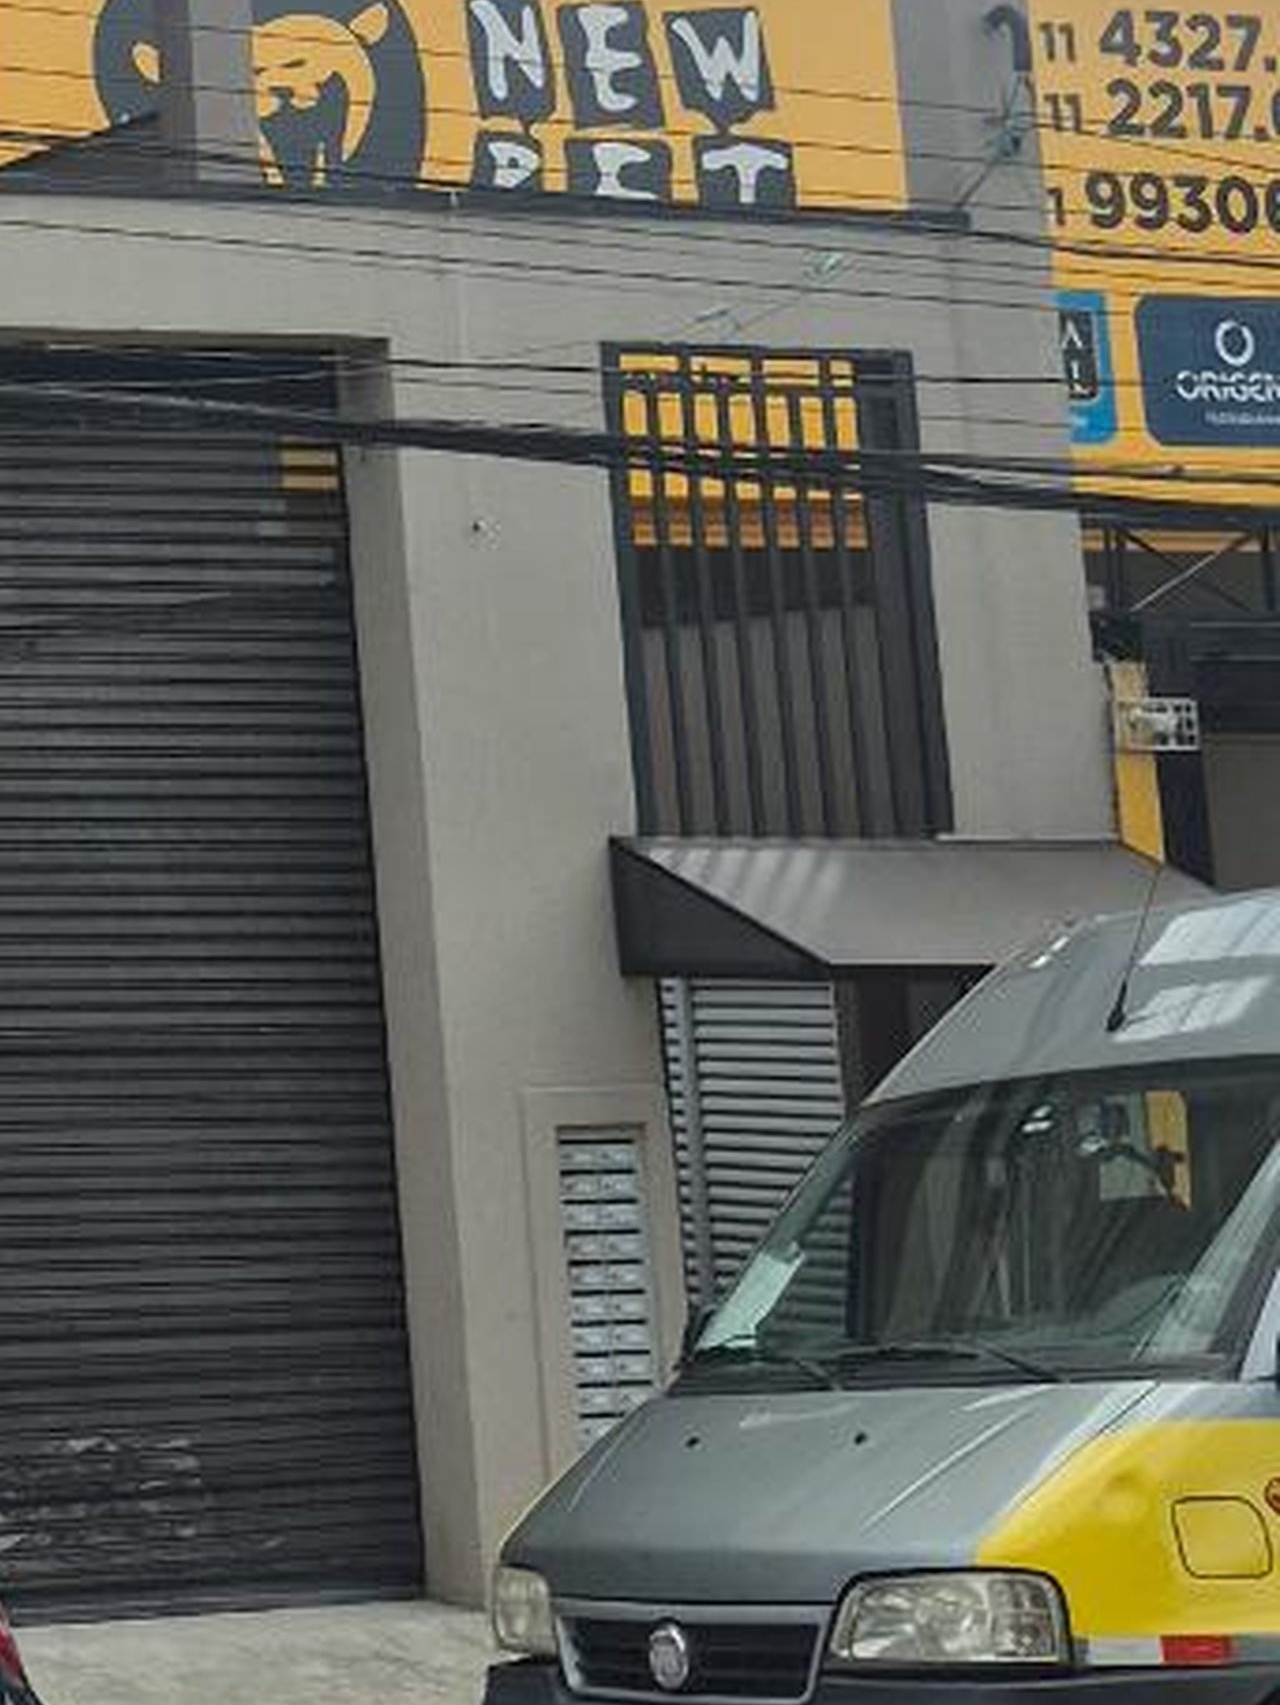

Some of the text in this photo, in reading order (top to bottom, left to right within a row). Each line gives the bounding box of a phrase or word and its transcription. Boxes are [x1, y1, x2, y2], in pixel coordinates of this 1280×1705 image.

[1038, 21, 1076, 62] 11
[1043, 77, 1280, 142] 11 2217.
